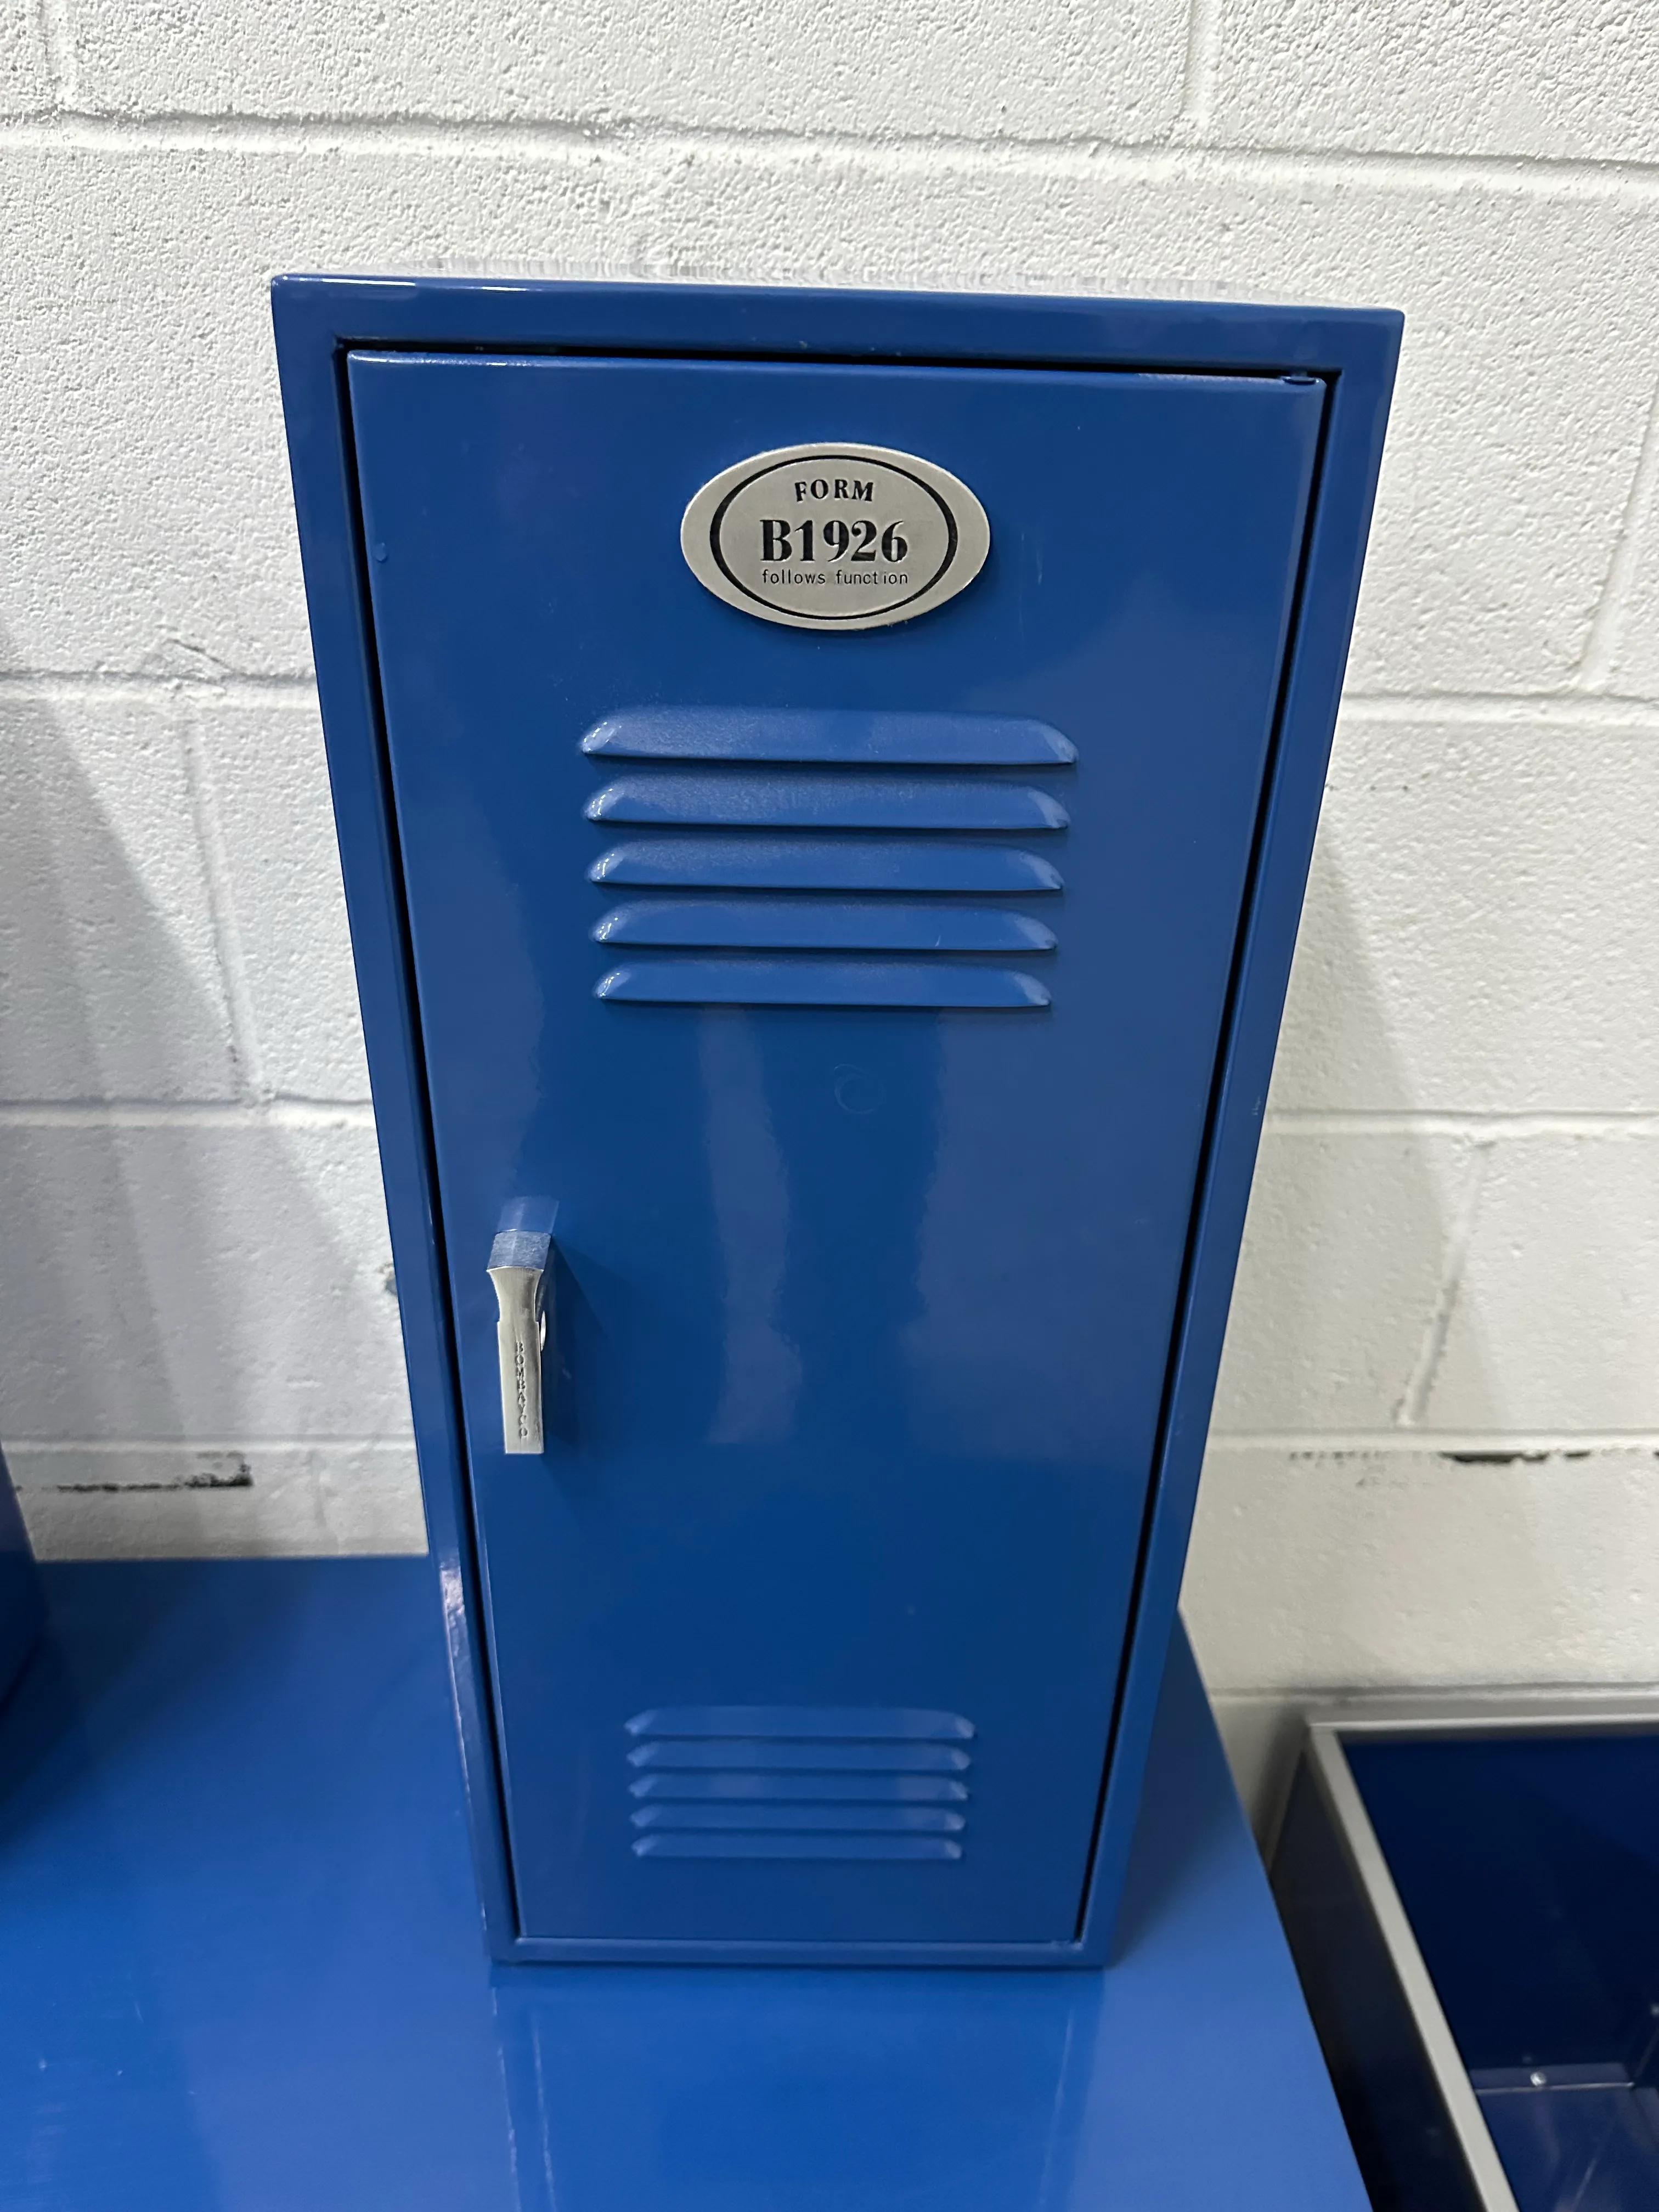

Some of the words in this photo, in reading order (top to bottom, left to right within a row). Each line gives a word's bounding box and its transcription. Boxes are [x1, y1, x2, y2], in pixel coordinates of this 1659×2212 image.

[794, 479, 873, 502] FORM
[760, 520, 908, 562] B1926
[762, 569, 826, 585] follows
[836, 569, 909, 585] function
